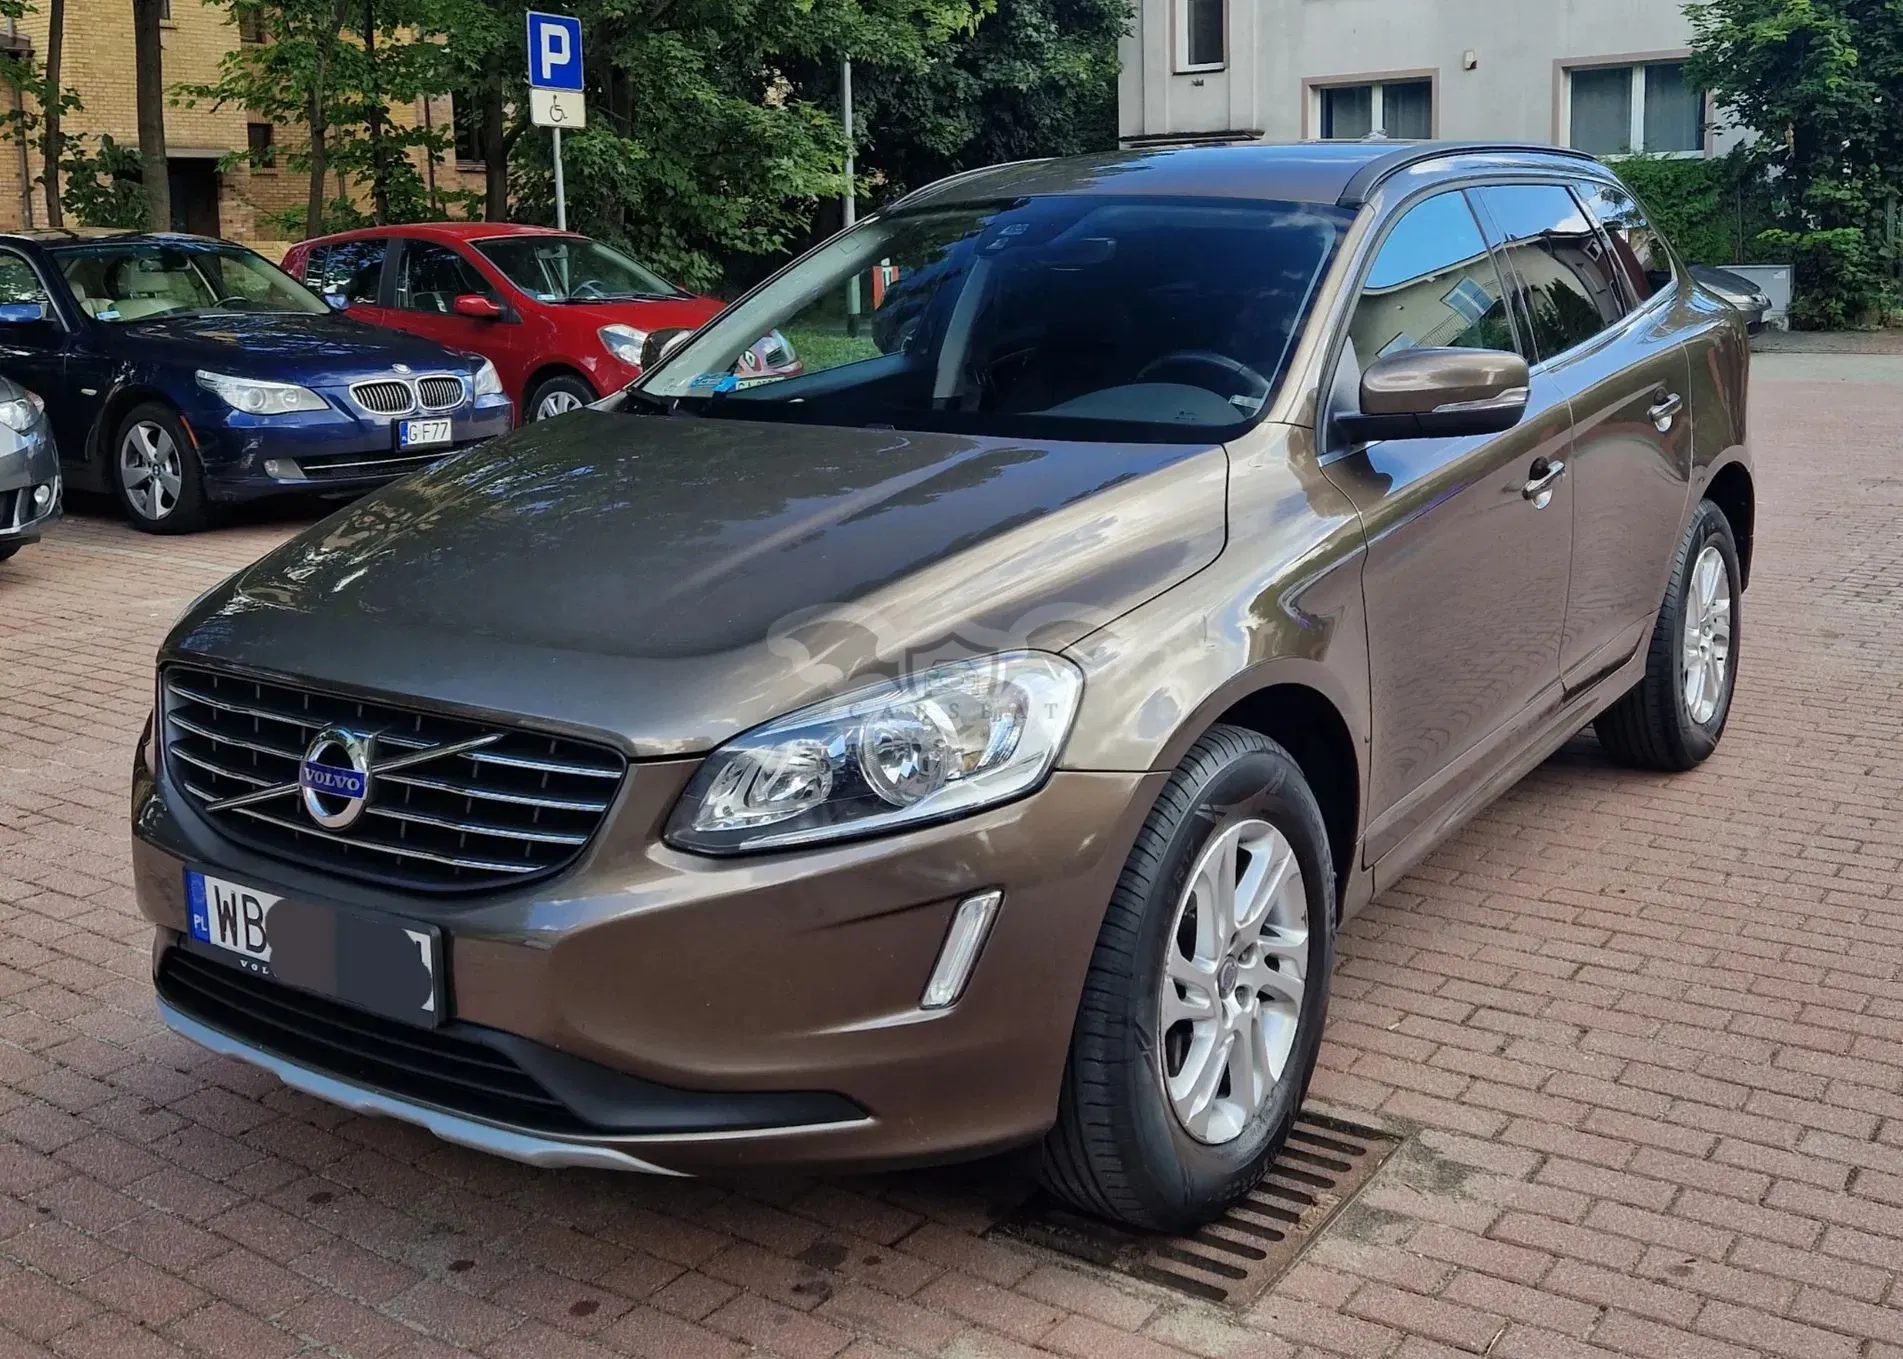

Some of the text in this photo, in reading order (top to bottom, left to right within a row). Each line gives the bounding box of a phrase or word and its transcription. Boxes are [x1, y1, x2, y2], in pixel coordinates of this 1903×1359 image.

[541, 22, 571, 79] P
[409, 421, 449, 442] G F77
[304, 766, 361, 791] VOLVO
[193, 912, 208, 932] PL
[214, 884, 267, 954] WB
